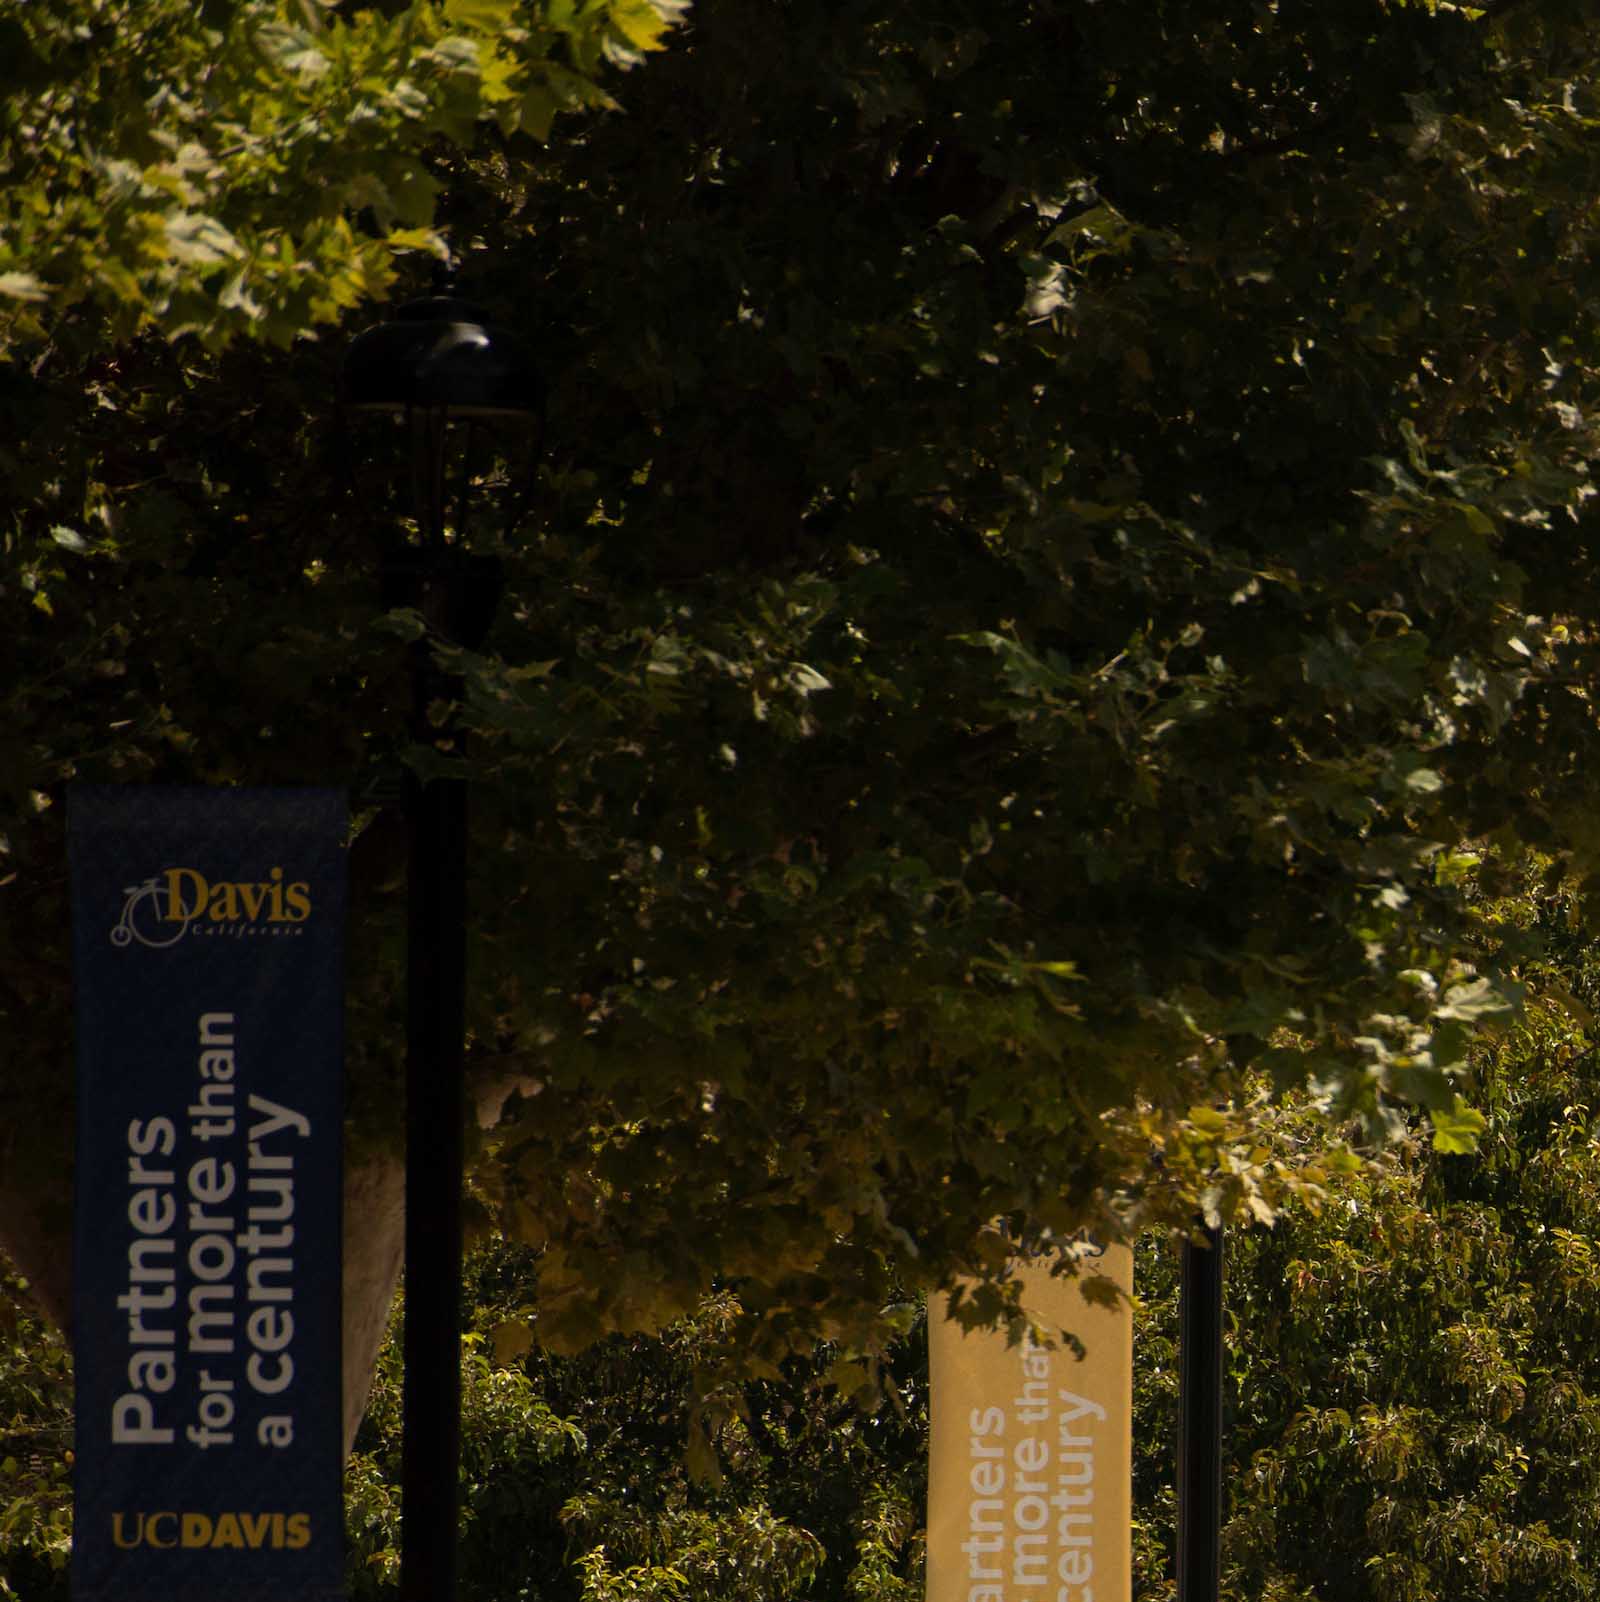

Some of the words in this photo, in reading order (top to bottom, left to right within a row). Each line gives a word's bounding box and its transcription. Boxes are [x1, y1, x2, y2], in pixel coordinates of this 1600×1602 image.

[161, 866, 312, 923] Davis
[187, 1011, 236, 1141] than
[111, 1114, 176, 1445] Partners
[187, 1156, 236, 1353] more
[236, 1093, 311, 1395] century
[186, 1368, 236, 1450] for
[256, 1415, 294, 1449] a
[111, 1512, 312, 1550] UCDAVIS
[1013, 1437, 1049, 1584] more
